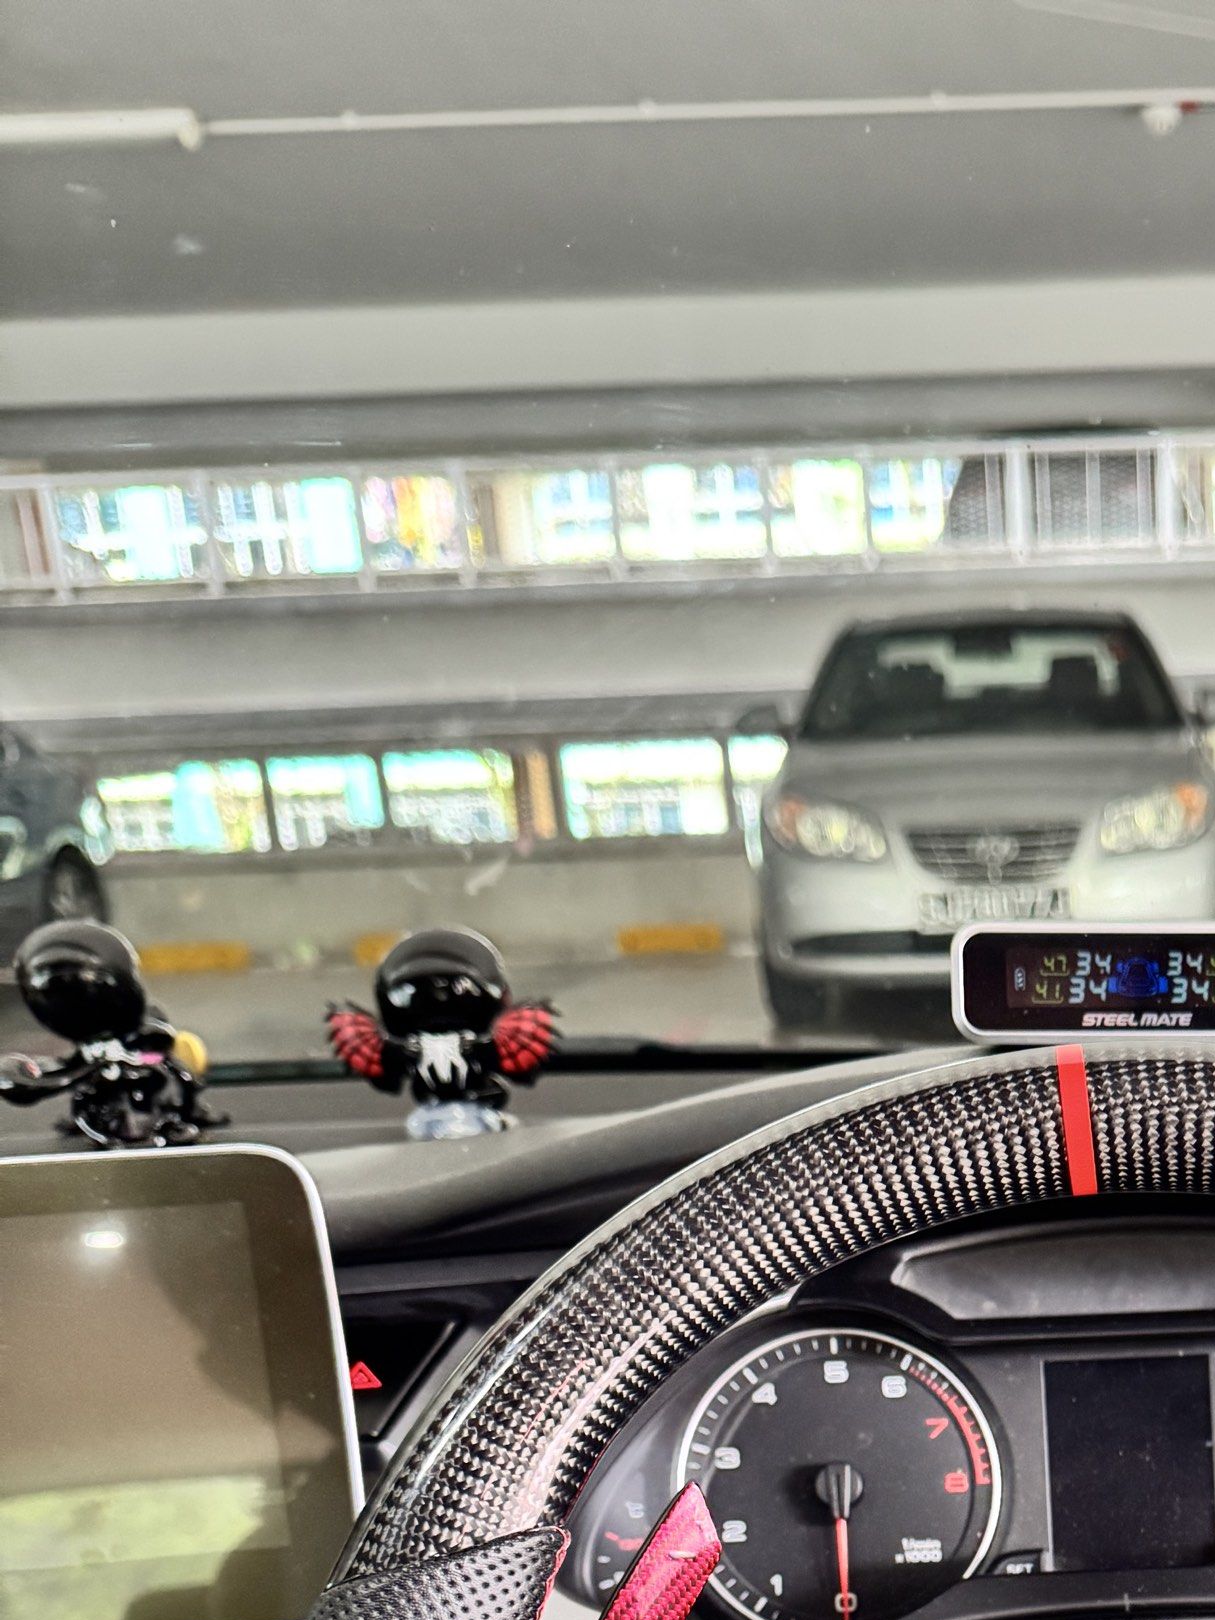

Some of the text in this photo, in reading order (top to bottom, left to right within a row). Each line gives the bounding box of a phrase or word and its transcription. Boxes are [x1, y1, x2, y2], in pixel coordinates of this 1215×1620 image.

[1075, 950, 1112, 977] 34
[1166, 951, 1204, 977] 34
[1068, 976, 1108, 1004] 34
[1170, 976, 1210, 1004] 34
[823, 1360, 849, 1384] 5
[752, 1382, 778, 1405] 4
[881, 1375, 907, 1398] 6
[925, 1417, 949, 1440] 7
[714, 1446, 741, 1470] 3
[944, 1471, 970, 1494] 8
[721, 1519, 748, 1543] 2
[769, 1573, 784, 1597] 1
